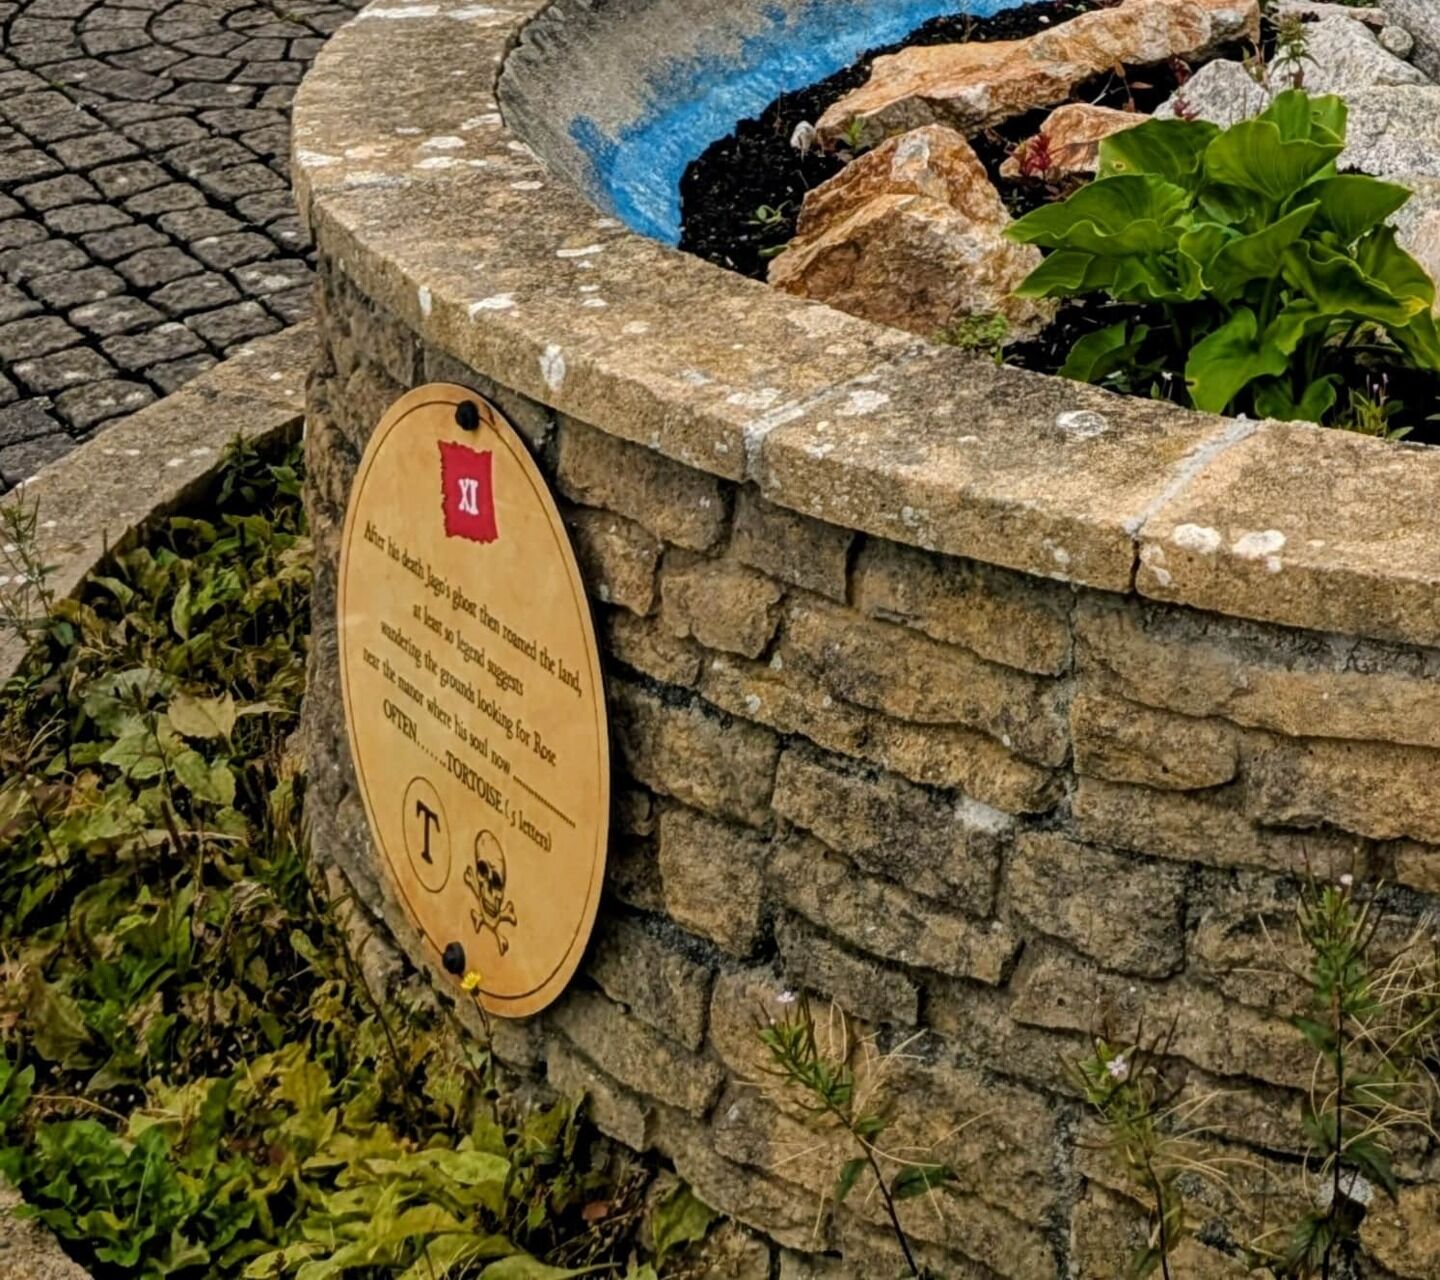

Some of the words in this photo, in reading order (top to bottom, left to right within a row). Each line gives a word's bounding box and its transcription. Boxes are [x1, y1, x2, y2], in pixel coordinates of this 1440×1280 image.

[458, 478, 479, 516] XI
[364, 520, 385, 551] After
[388, 536, 400, 561] his
[402, 548, 424, 580] death
[425, 564, 451, 599] Jago's
[452, 586, 477, 618] ghost
[480, 603, 500, 635] then
[502, 625, 537, 661] roamed
[540, 646, 555, 675] the
[558, 658, 582, 699] land,
[413, 604, 421, 621] at
[424, 605, 443, 637] least
[444, 627, 454, 645] so
[457, 629, 485, 667] legend
[487, 657, 524, 697] suggests
[363, 647, 380, 671] near
[383, 658, 396, 684] the
[397, 676, 424, 706] manor
[426, 696, 452, 730] where
[454, 713, 467, 742] his
[469, 737, 488, 759] soul
[491, 750, 511, 775] now
[381, 620, 422, 669] wandering
[424, 649, 438, 676] the
[440, 668, 475, 704] grounds
[477, 689, 514, 740] looking
[515, 718, 531, 747] for
[416, 799, 441, 865] T
[519, 810, 552, 854] letters)
